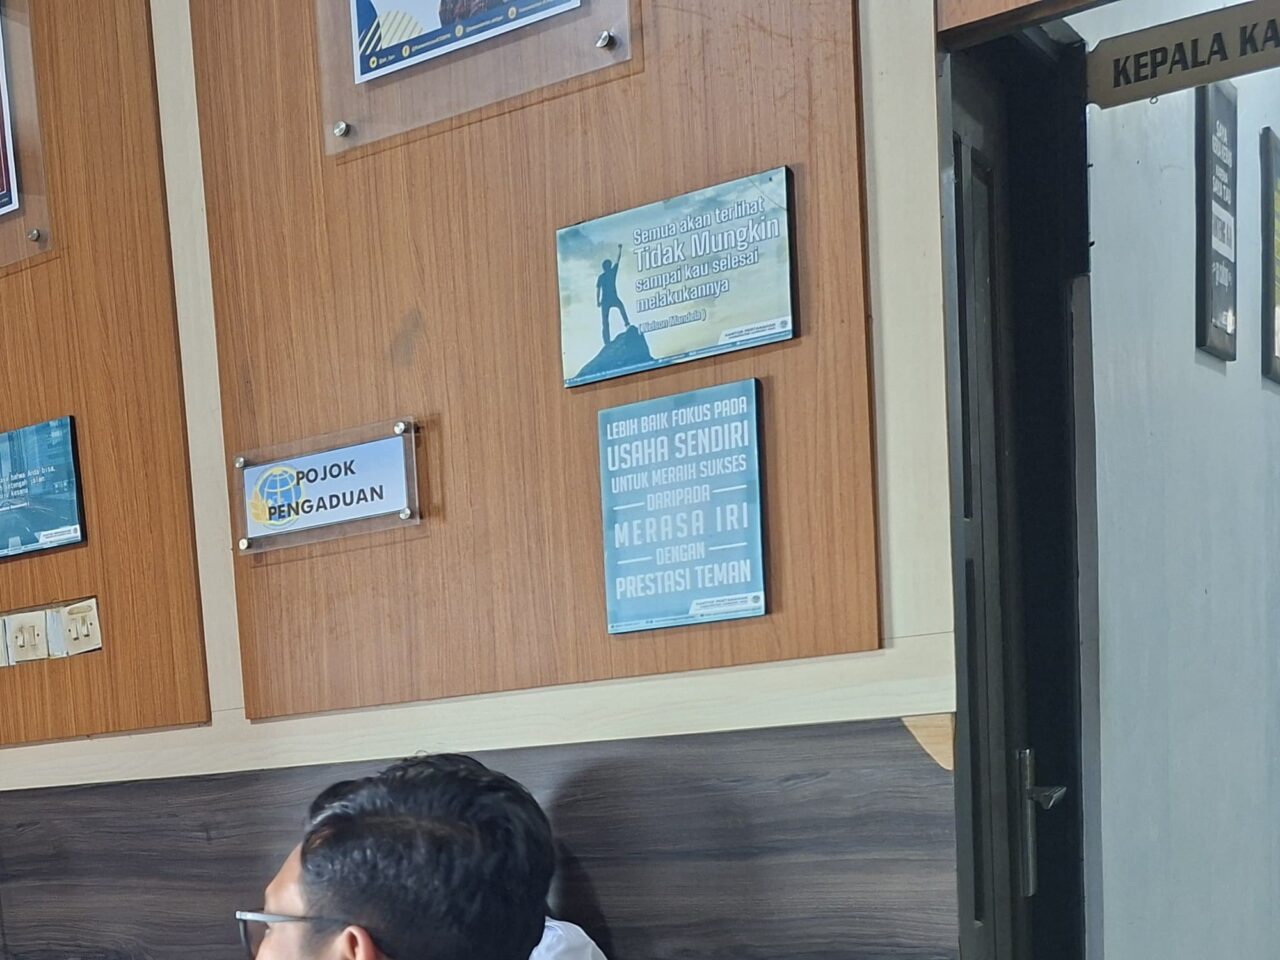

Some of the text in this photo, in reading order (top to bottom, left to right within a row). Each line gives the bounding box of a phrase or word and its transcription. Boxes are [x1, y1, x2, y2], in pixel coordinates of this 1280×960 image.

[1113, 31, 1228, 88] KEPALA
[633, 196, 765, 246] Semua akan terlihat
[633, 216, 780, 272] Tidak Mungkin
[635, 248, 760, 293] sampai kau selesai
[636, 279, 730, 313] melakukannya
[607, 396, 747, 440] LEBIH BAIK FOKUS PADA
[607, 420, 749, 471] USAHA SENDIRI
[296, 459, 356, 486] POJOK
[611, 454, 747, 494] UNTUK MERAIH SUKSES
[268, 485, 384, 521] PENGADUAN
[646, 484, 710, 511] DARIPADA
[614, 502, 749, 549] MERASA IRI
[655, 541, 705, 565] DENGAN
[616, 559, 751, 600] PRESTASI TEMAN
